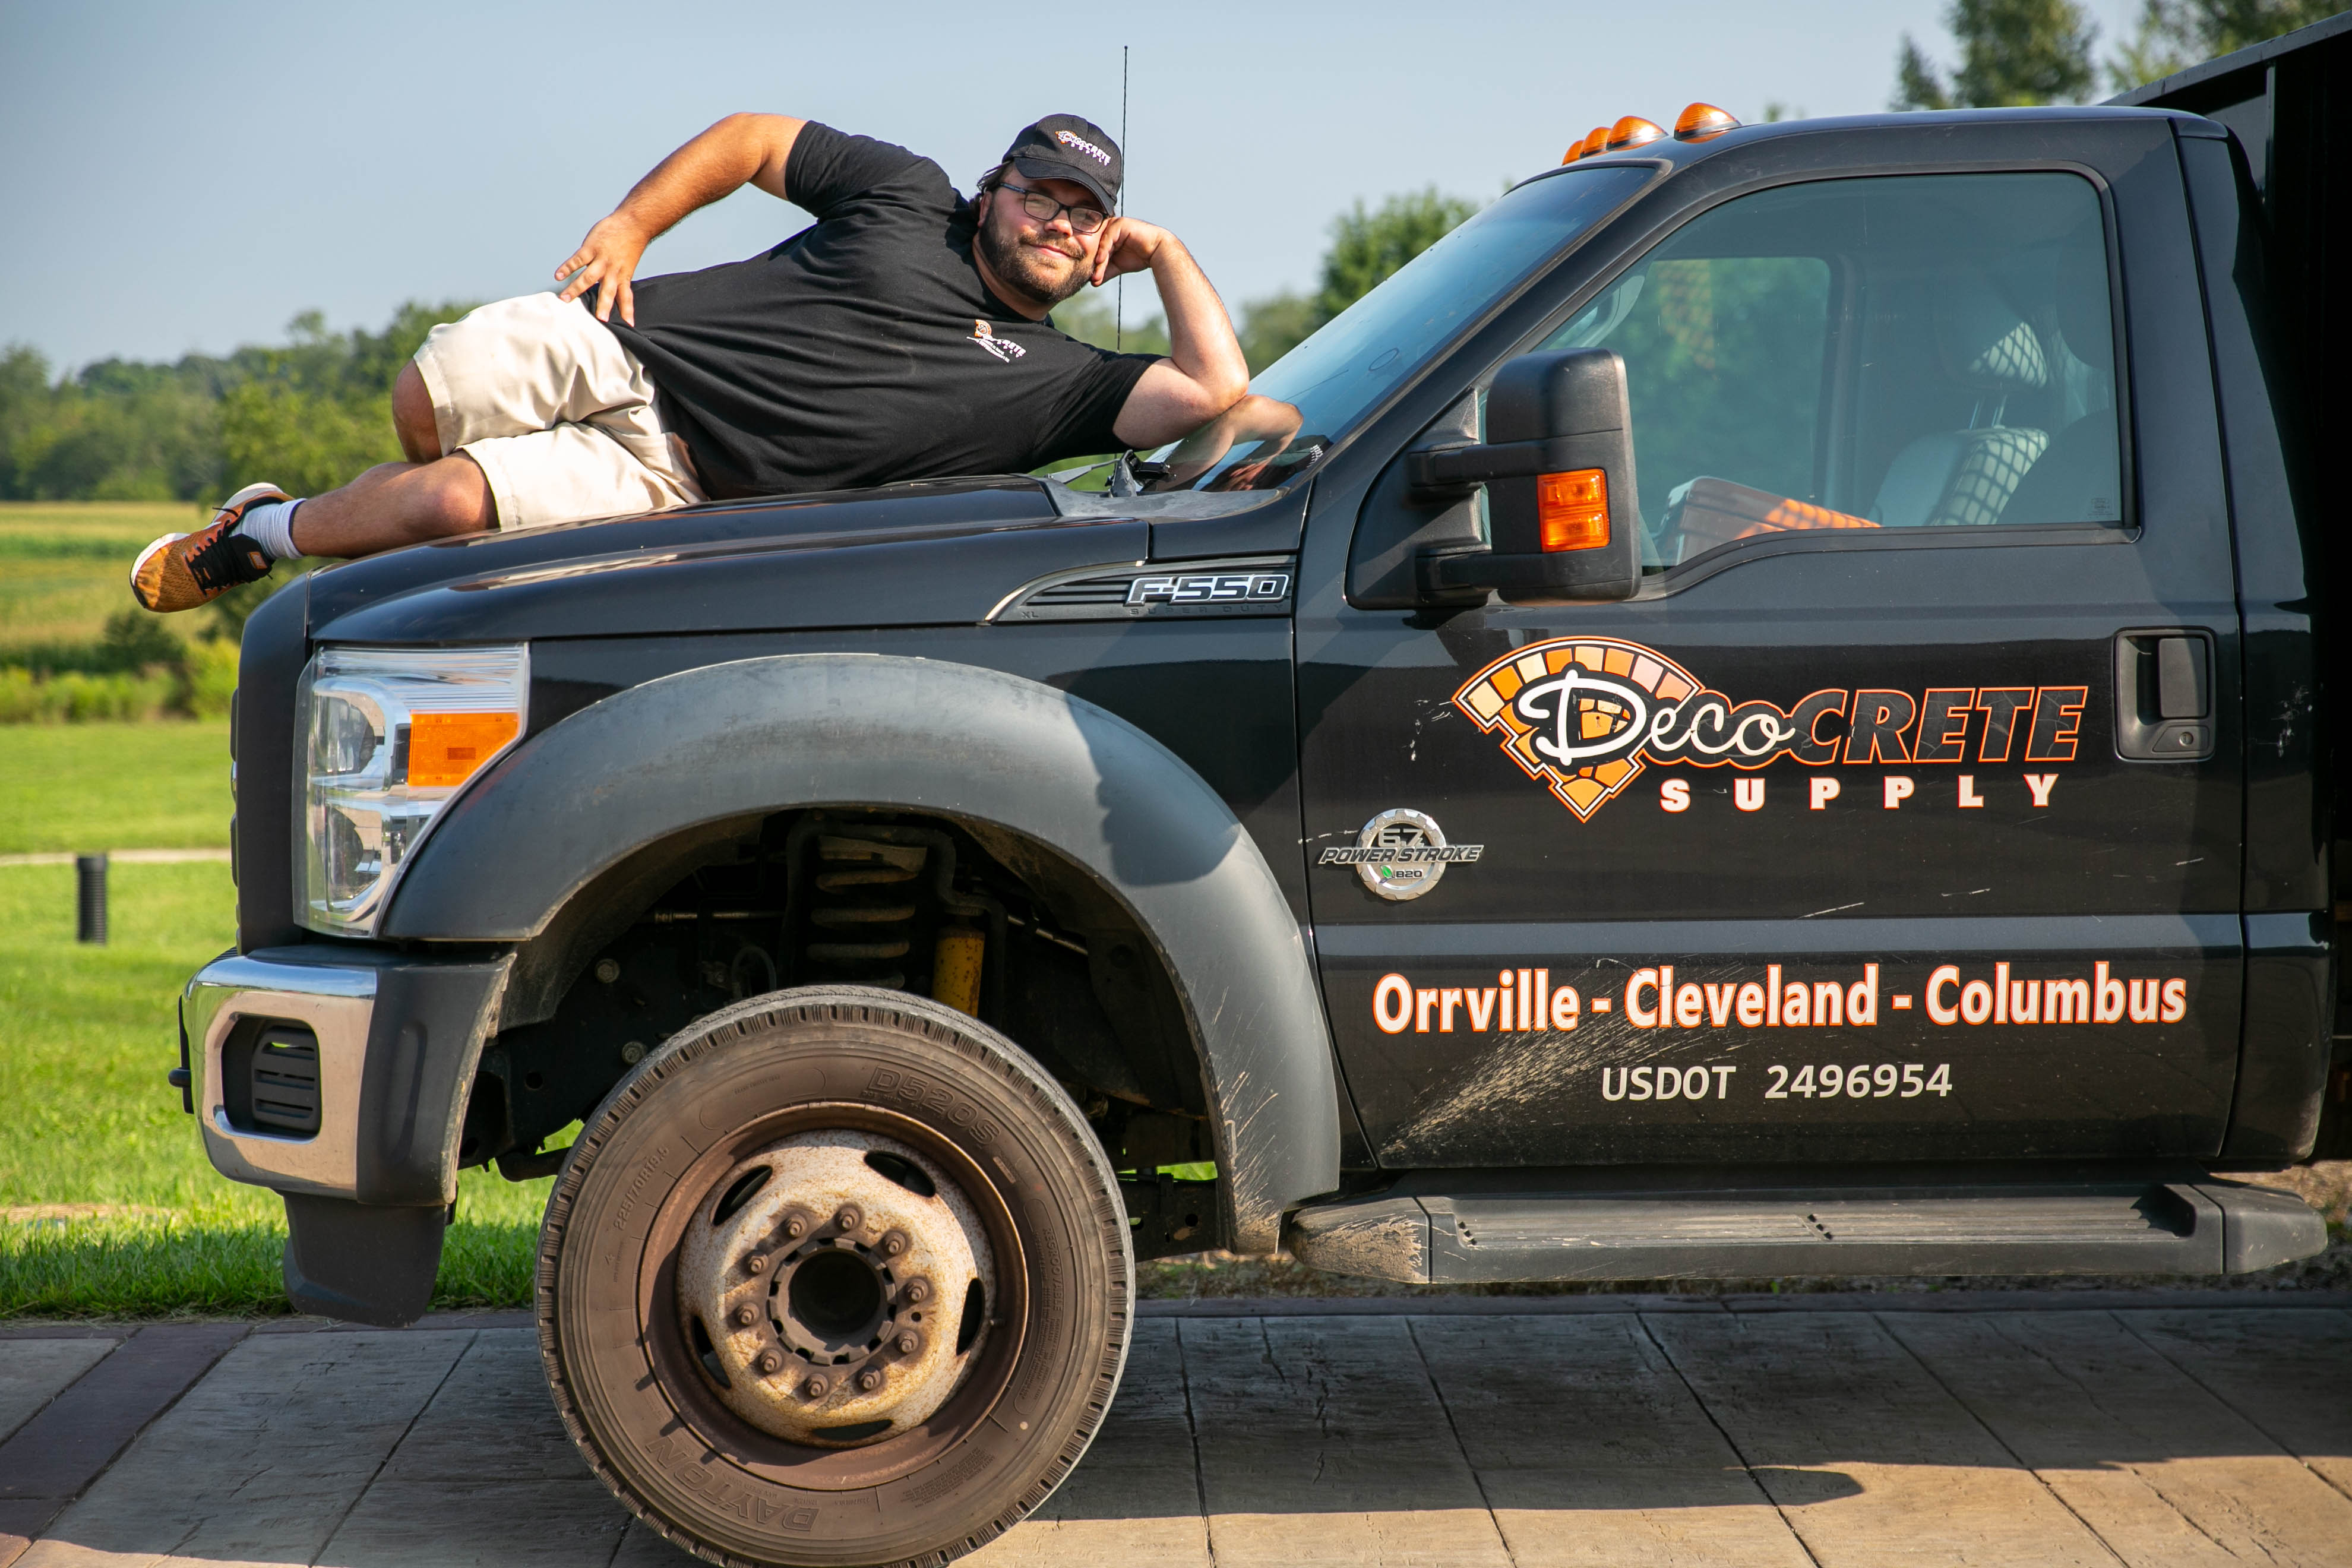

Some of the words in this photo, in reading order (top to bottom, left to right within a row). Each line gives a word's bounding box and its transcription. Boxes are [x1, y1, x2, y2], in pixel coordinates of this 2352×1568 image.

[1130, 606, 1207, 616] SUPER
[1222, 604, 1283, 614] DUTY
[1660, 773, 2060, 812] SUPPLY
[1317, 847, 1398, 864] POWER
[1397, 845, 1484, 863] STROKE
[1373, 968, 1580, 1034] Orrville
[1624, 963, 1879, 1030] Cleveland
[1925, 961, 2186, 1026] Columbus
[867, 1066, 1001, 1145] D520S
[1602, 1066, 1737, 1101] USDOT
[1765, 1064, 1952, 1099] 2496954
[614, 1145, 669, 1231] 225/70R19.5
[646, 1436, 822, 1532] DAYTON
